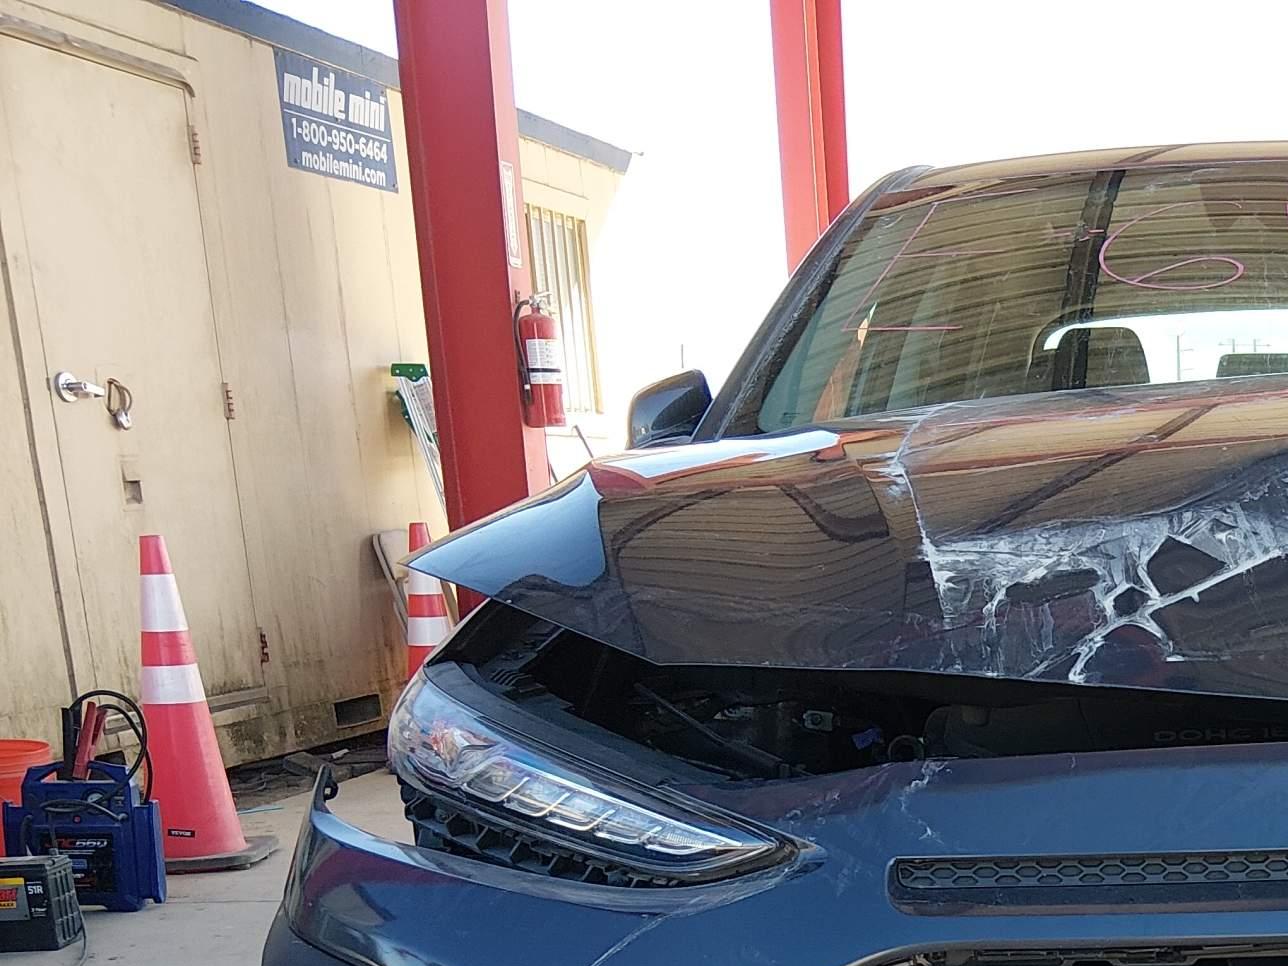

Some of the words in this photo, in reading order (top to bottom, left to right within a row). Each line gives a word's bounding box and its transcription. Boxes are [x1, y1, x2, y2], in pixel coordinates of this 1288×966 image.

[284, 67, 346, 120] mobile
[349, 91, 387, 131] mini
[291, 118, 388, 163] 1-800-950-6464
[302, 151, 386, 186] mobilemini.com
[27, 885, 44, 895] 51R
